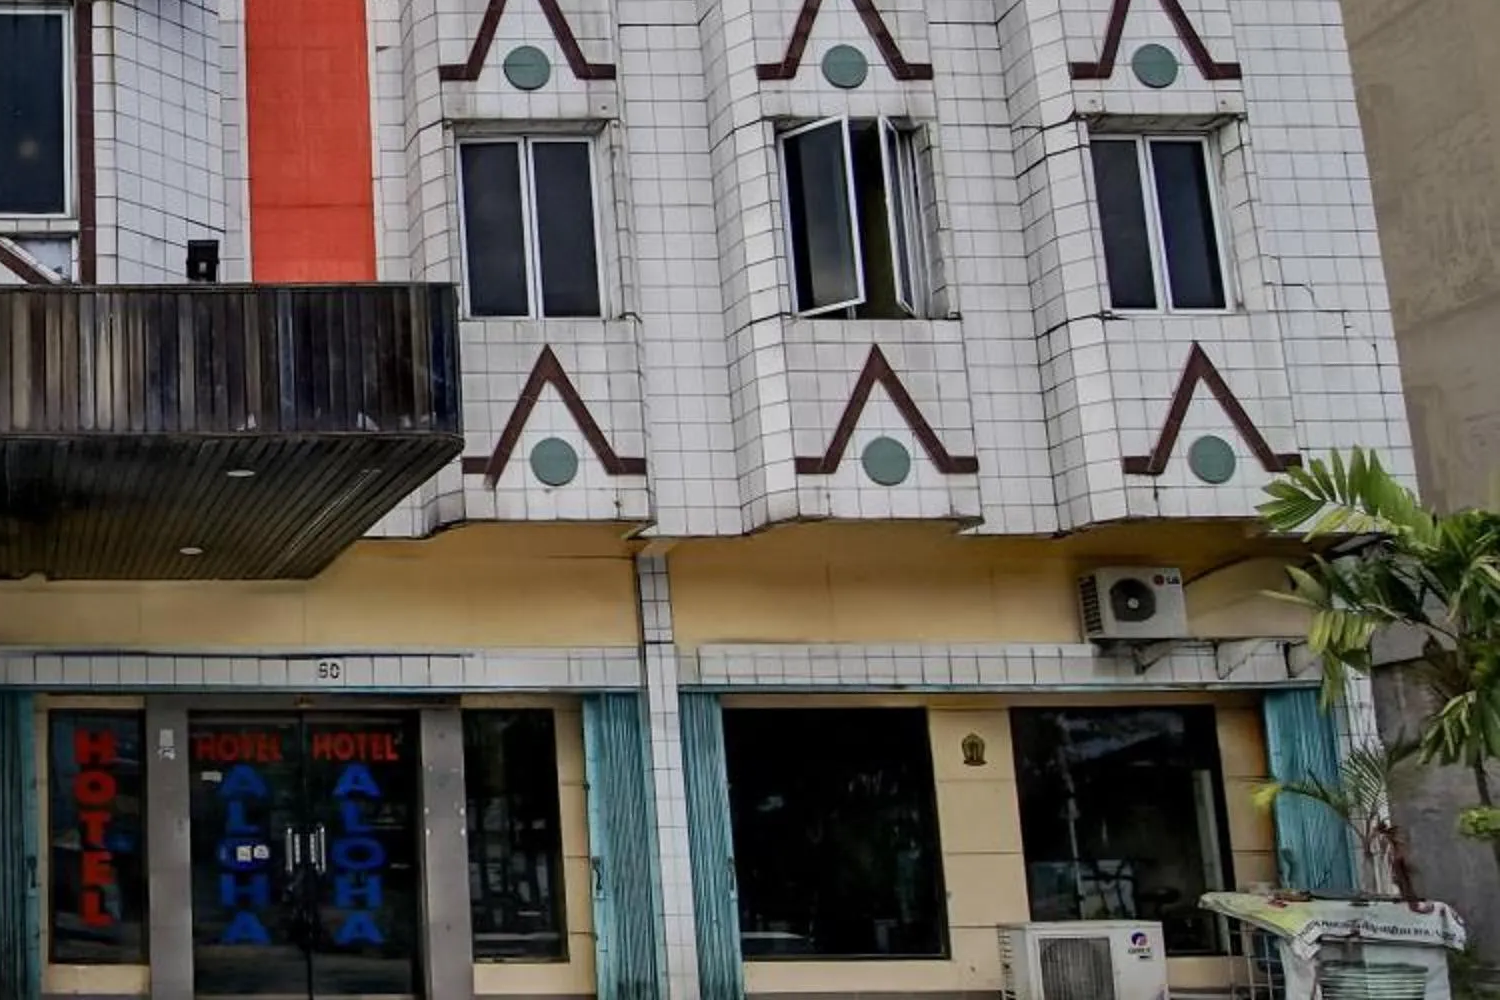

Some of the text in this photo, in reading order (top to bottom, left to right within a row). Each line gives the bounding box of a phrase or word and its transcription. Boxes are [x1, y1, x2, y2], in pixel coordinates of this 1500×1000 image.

[72, 728, 118, 926] HOTEL
[194, 732, 283, 762] HOTEL
[312, 732, 399, 762] HOTEL
[217, 763, 272, 945] ALOHA
[332, 762, 387, 945] ALOHA
